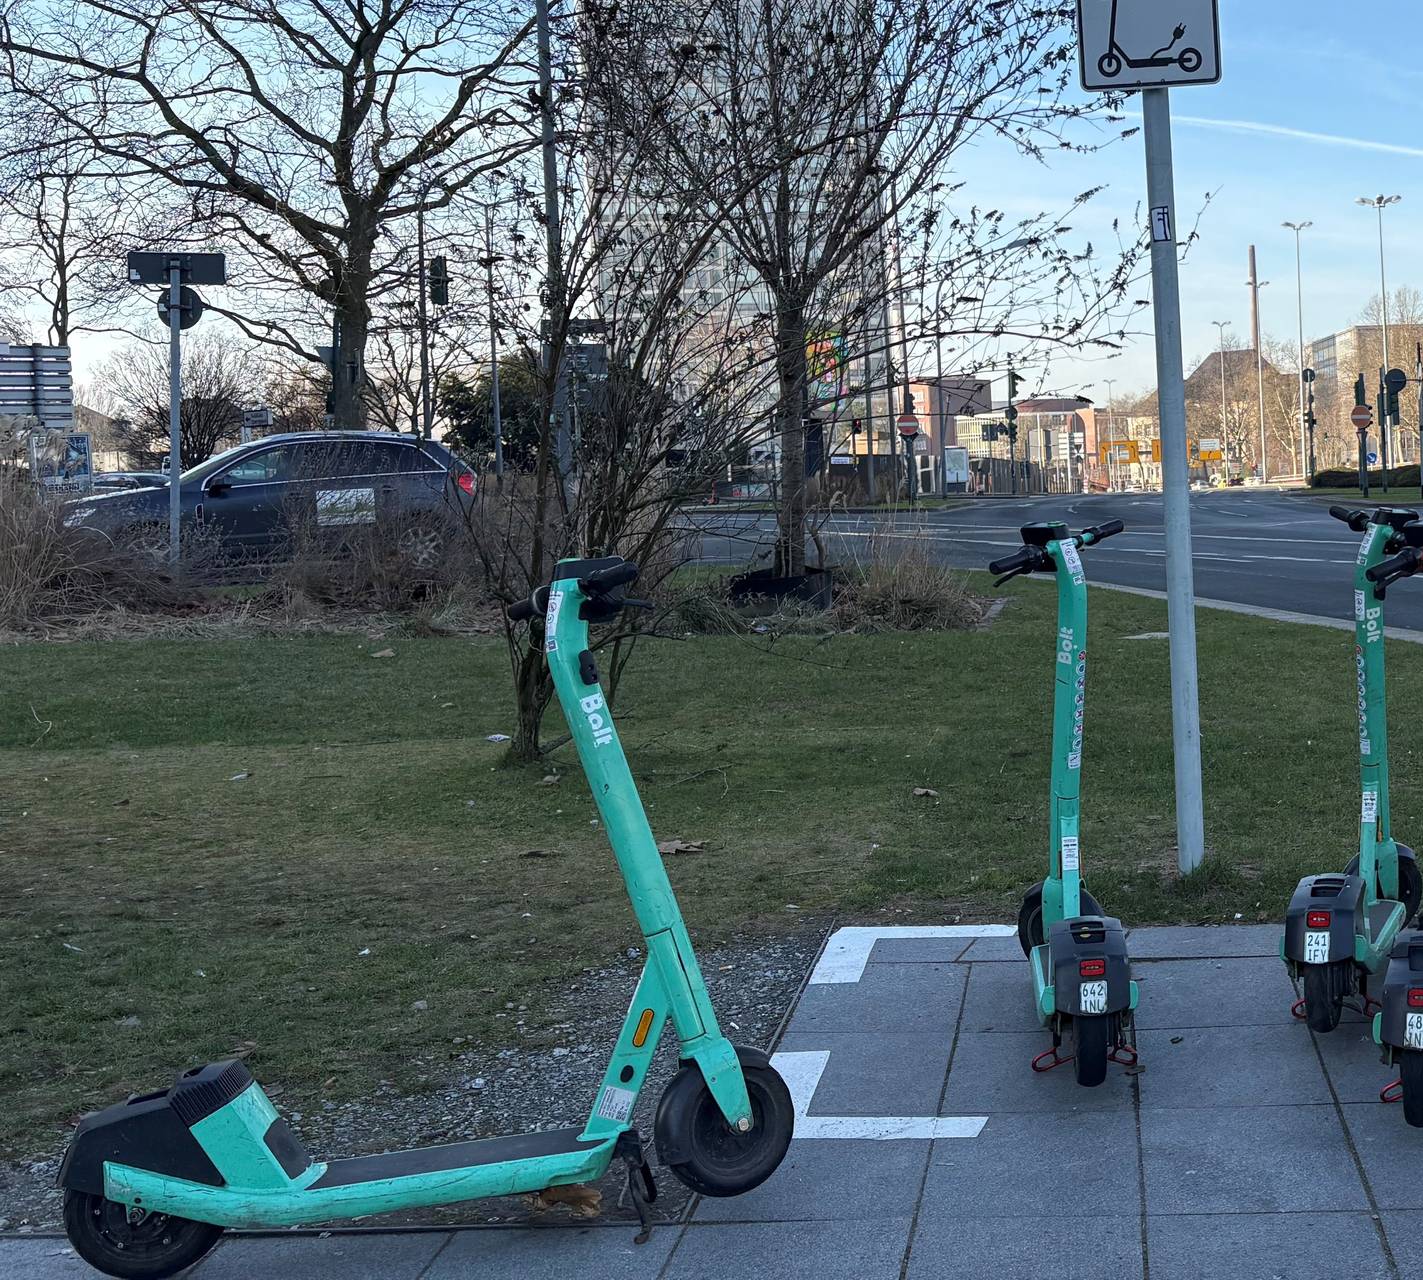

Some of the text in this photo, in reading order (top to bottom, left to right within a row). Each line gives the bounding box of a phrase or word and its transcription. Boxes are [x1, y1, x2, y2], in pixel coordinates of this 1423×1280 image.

[1366, 606, 1381, 643] Bolt
[1057, 626, 1073, 665] Bolt
[579, 692, 613, 748] Bolt
[1307, 934, 1327, 947] 241
[1308, 949, 1327, 962] IFY
[1082, 983, 1104, 998] 642
